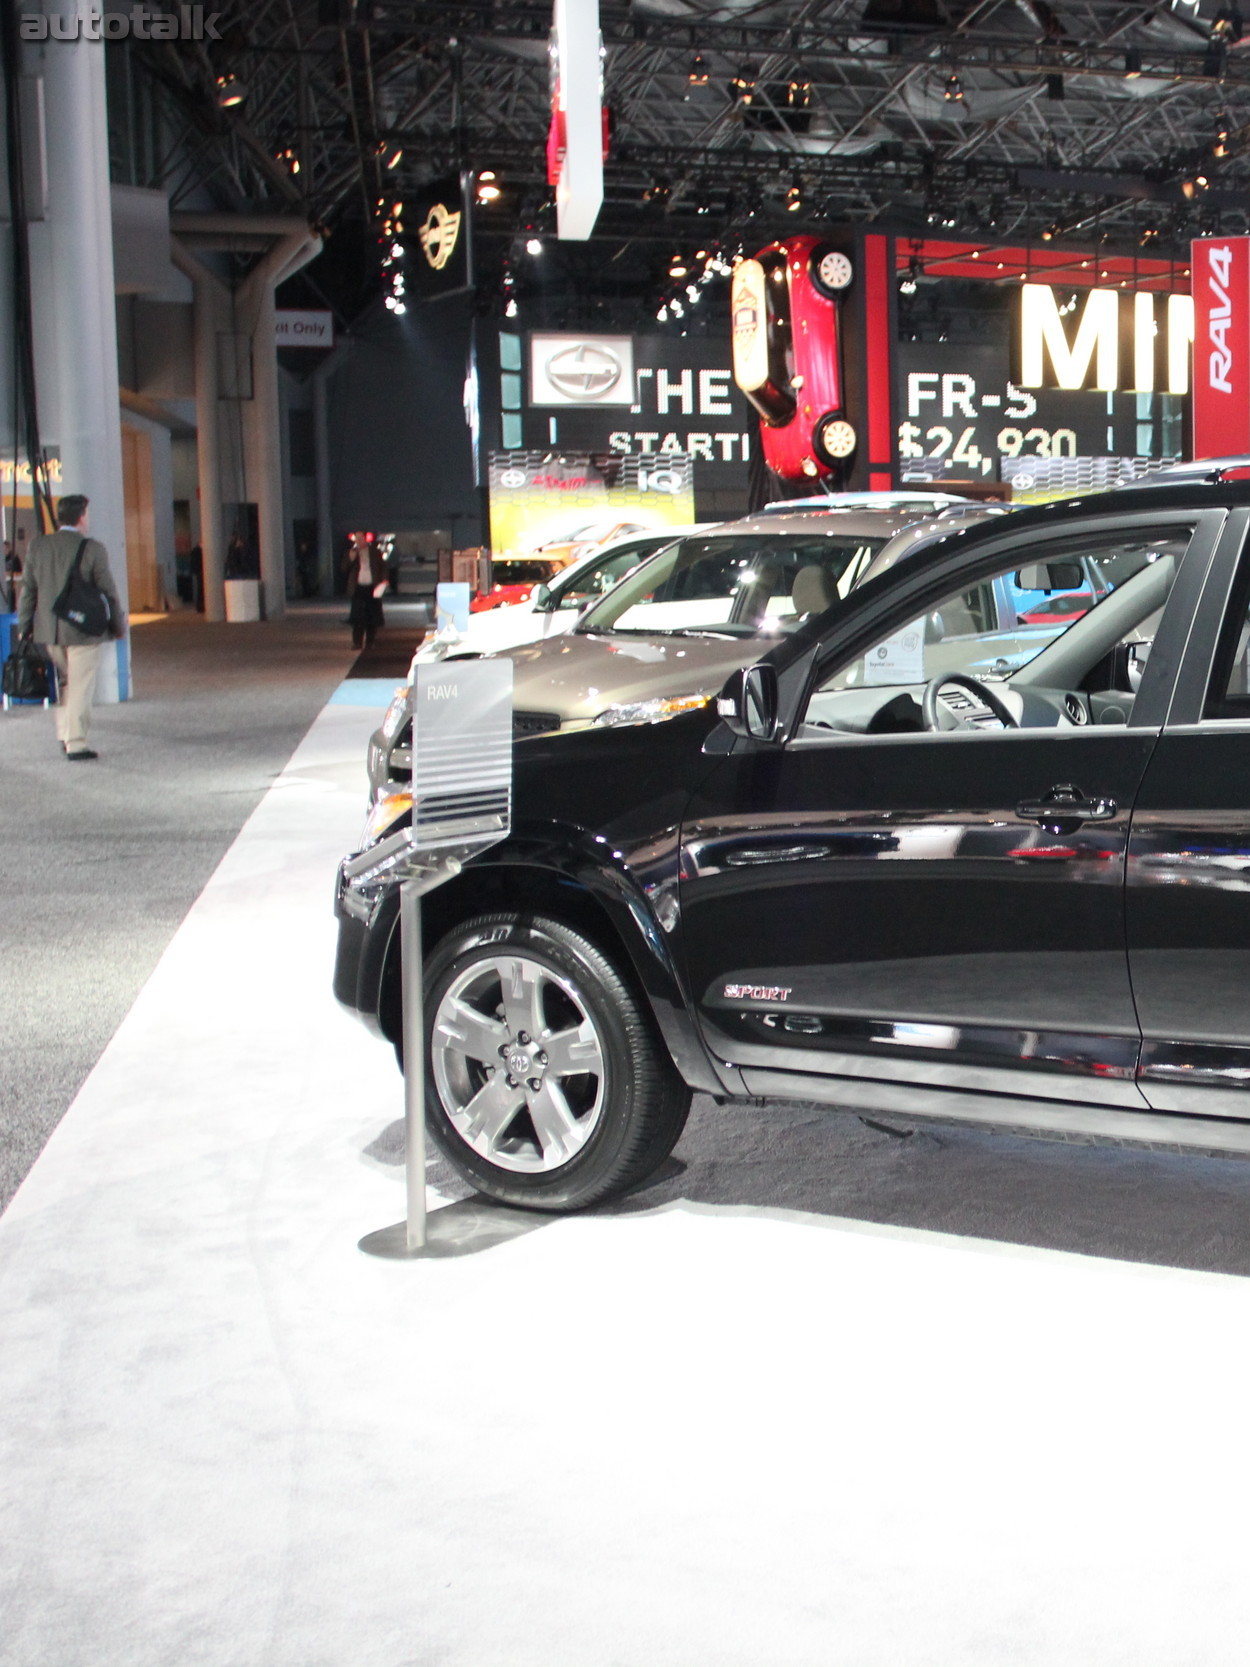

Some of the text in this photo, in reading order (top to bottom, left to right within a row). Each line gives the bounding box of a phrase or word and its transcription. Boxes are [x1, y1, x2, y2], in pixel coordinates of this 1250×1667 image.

[293, 322, 325, 337] Only
[1209, 246, 1233, 394] RAV4
[907, 373, 1037, 418] FR-S
[898, 421, 1077, 476] $24,930
[637, 470, 682, 494] IQ
[427, 684, 458, 700] RAV4
[724, 983, 792, 1001] SPORT
